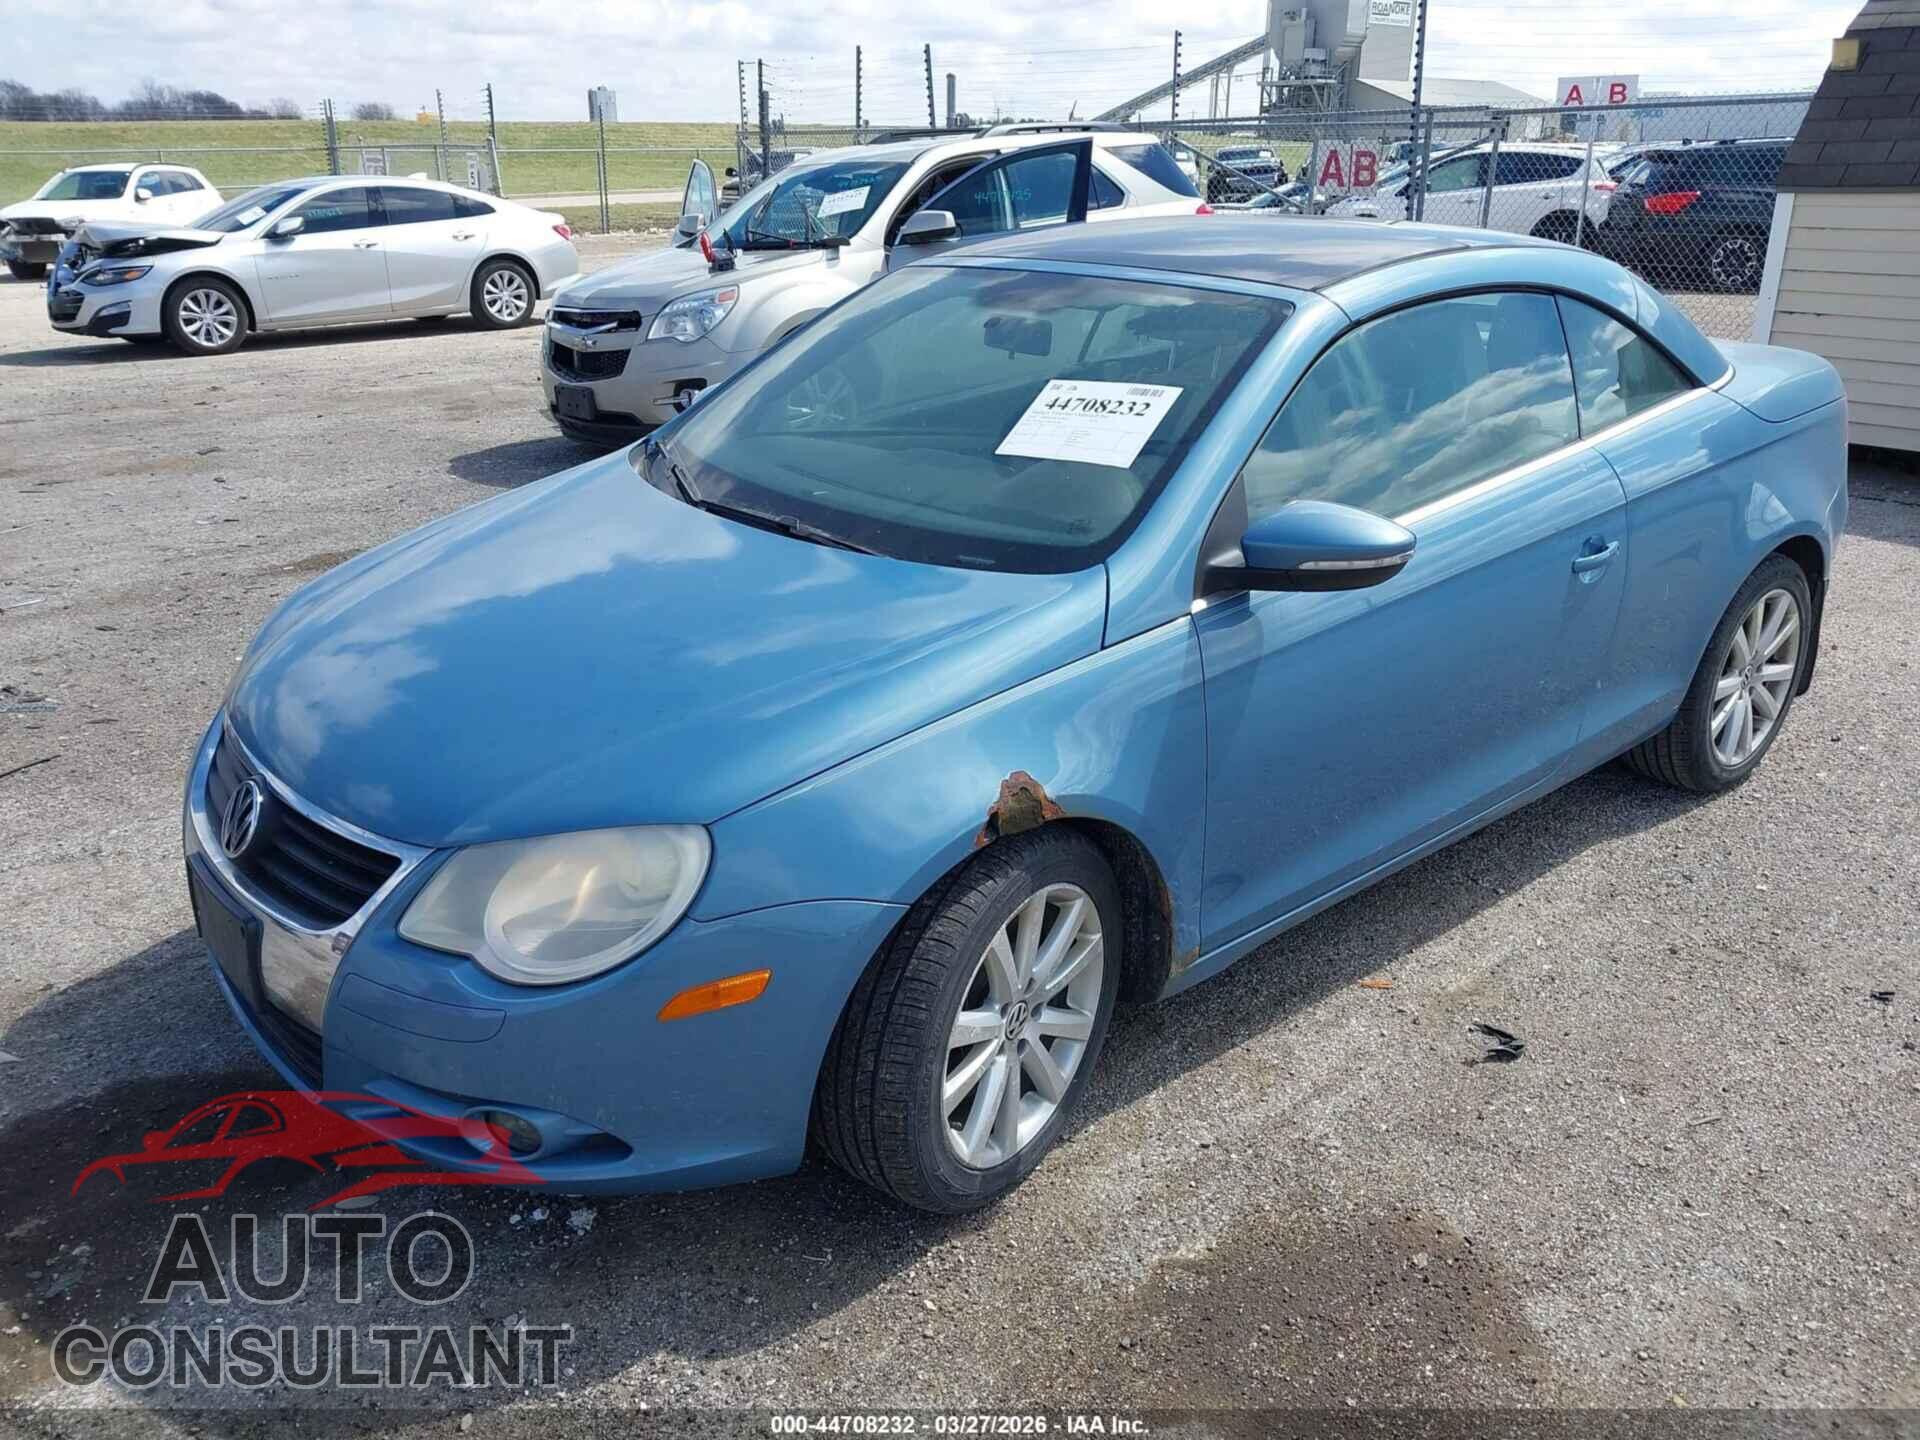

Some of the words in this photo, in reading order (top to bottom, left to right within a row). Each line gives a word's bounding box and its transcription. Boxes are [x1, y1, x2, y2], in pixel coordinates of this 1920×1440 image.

[1371, 1, 1410, 15] ROANOKE
[1563, 84, 1583, 105] A
[1608, 82, 1627, 104] B
[1319, 149, 1345, 187] A
[1353, 150, 1377, 187] B
[1045, 396, 1151, 417] 44708232
